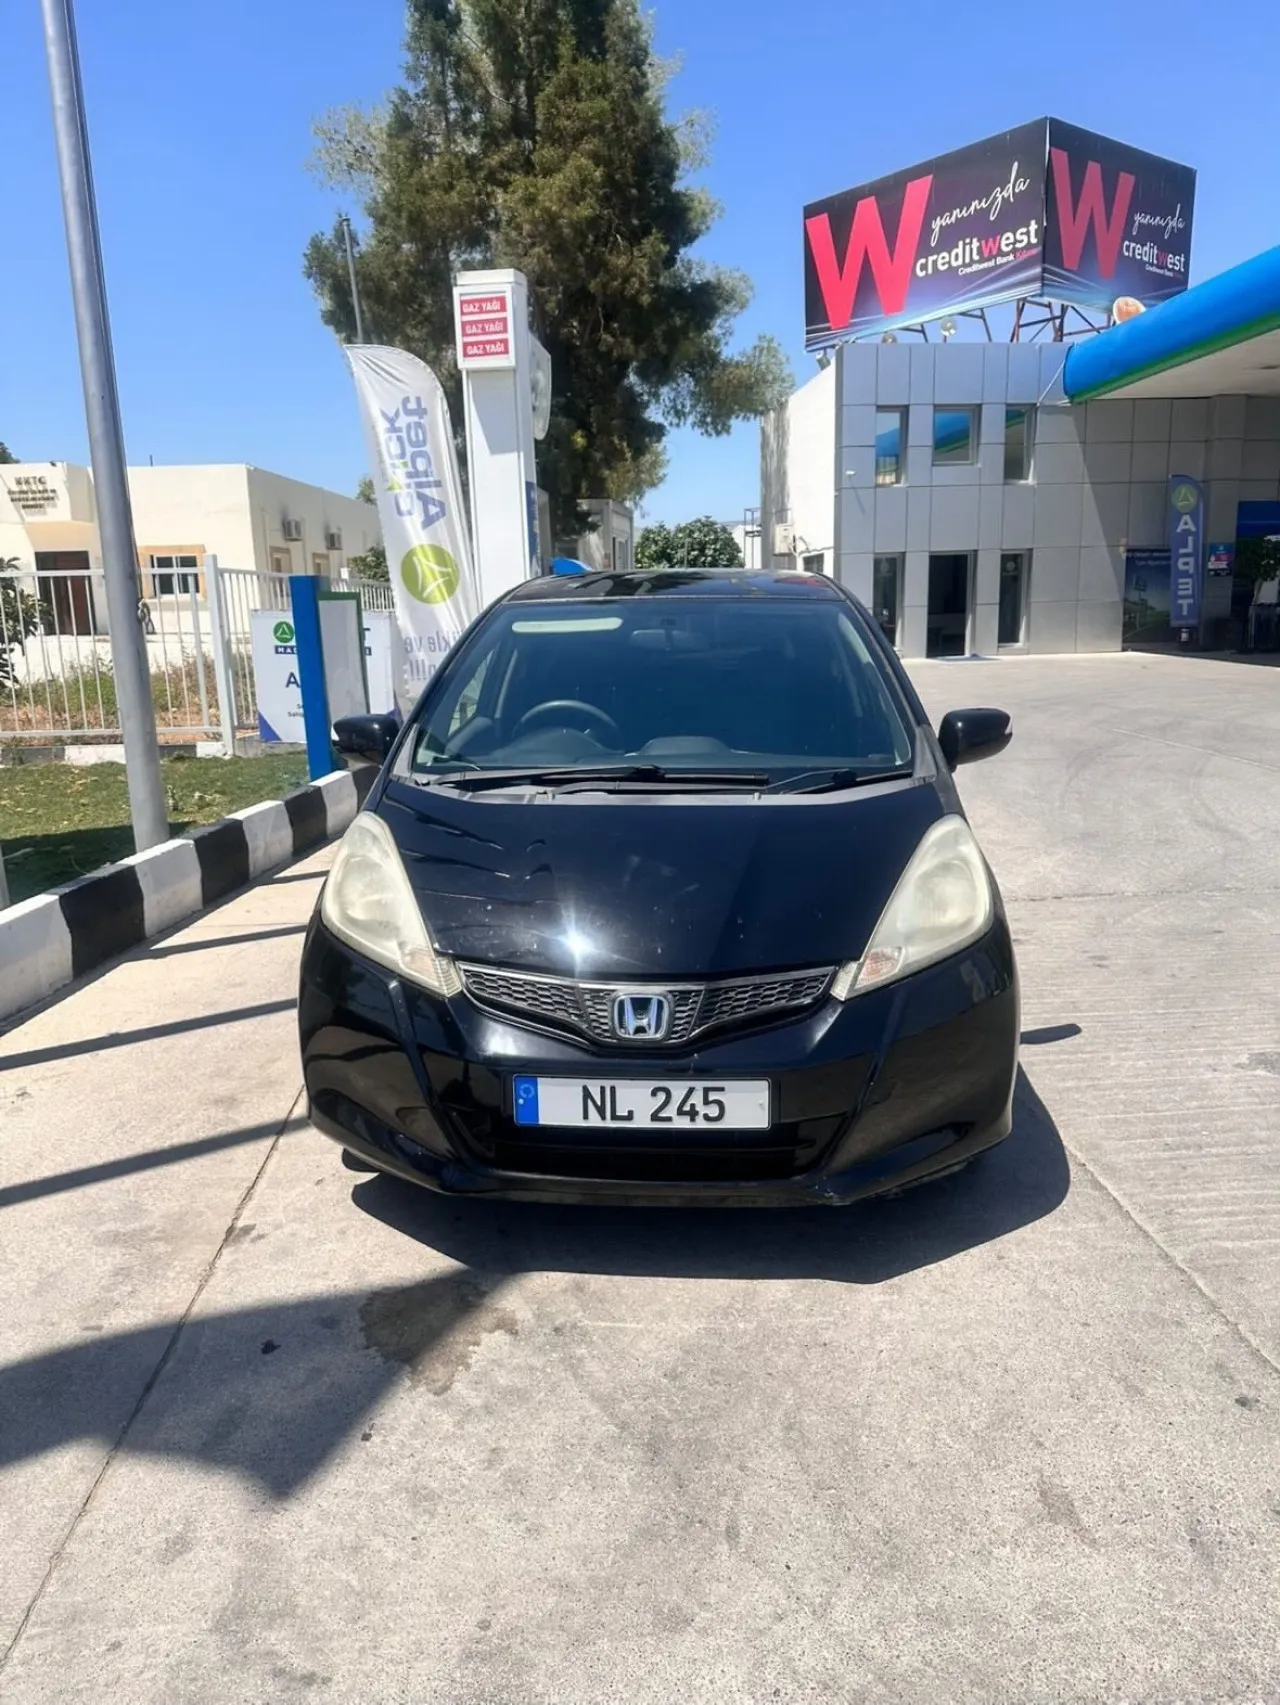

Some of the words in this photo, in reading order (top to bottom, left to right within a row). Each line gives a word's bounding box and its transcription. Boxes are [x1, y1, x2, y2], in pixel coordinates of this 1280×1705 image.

[931, 161, 1031, 247] yanınızda
[1050, 146, 1136, 279] W
[805, 173, 934, 331] W
[915, 219, 1039, 278] creditwest
[1122, 240, 1185, 272] creditwest
[462, 302, 480, 314] GAZ
[465, 323, 483, 335] GAZ
[466, 344, 485, 356] GAZ
[582, 1085, 634, 1122] NL
[650, 1086, 726, 1123] 245
